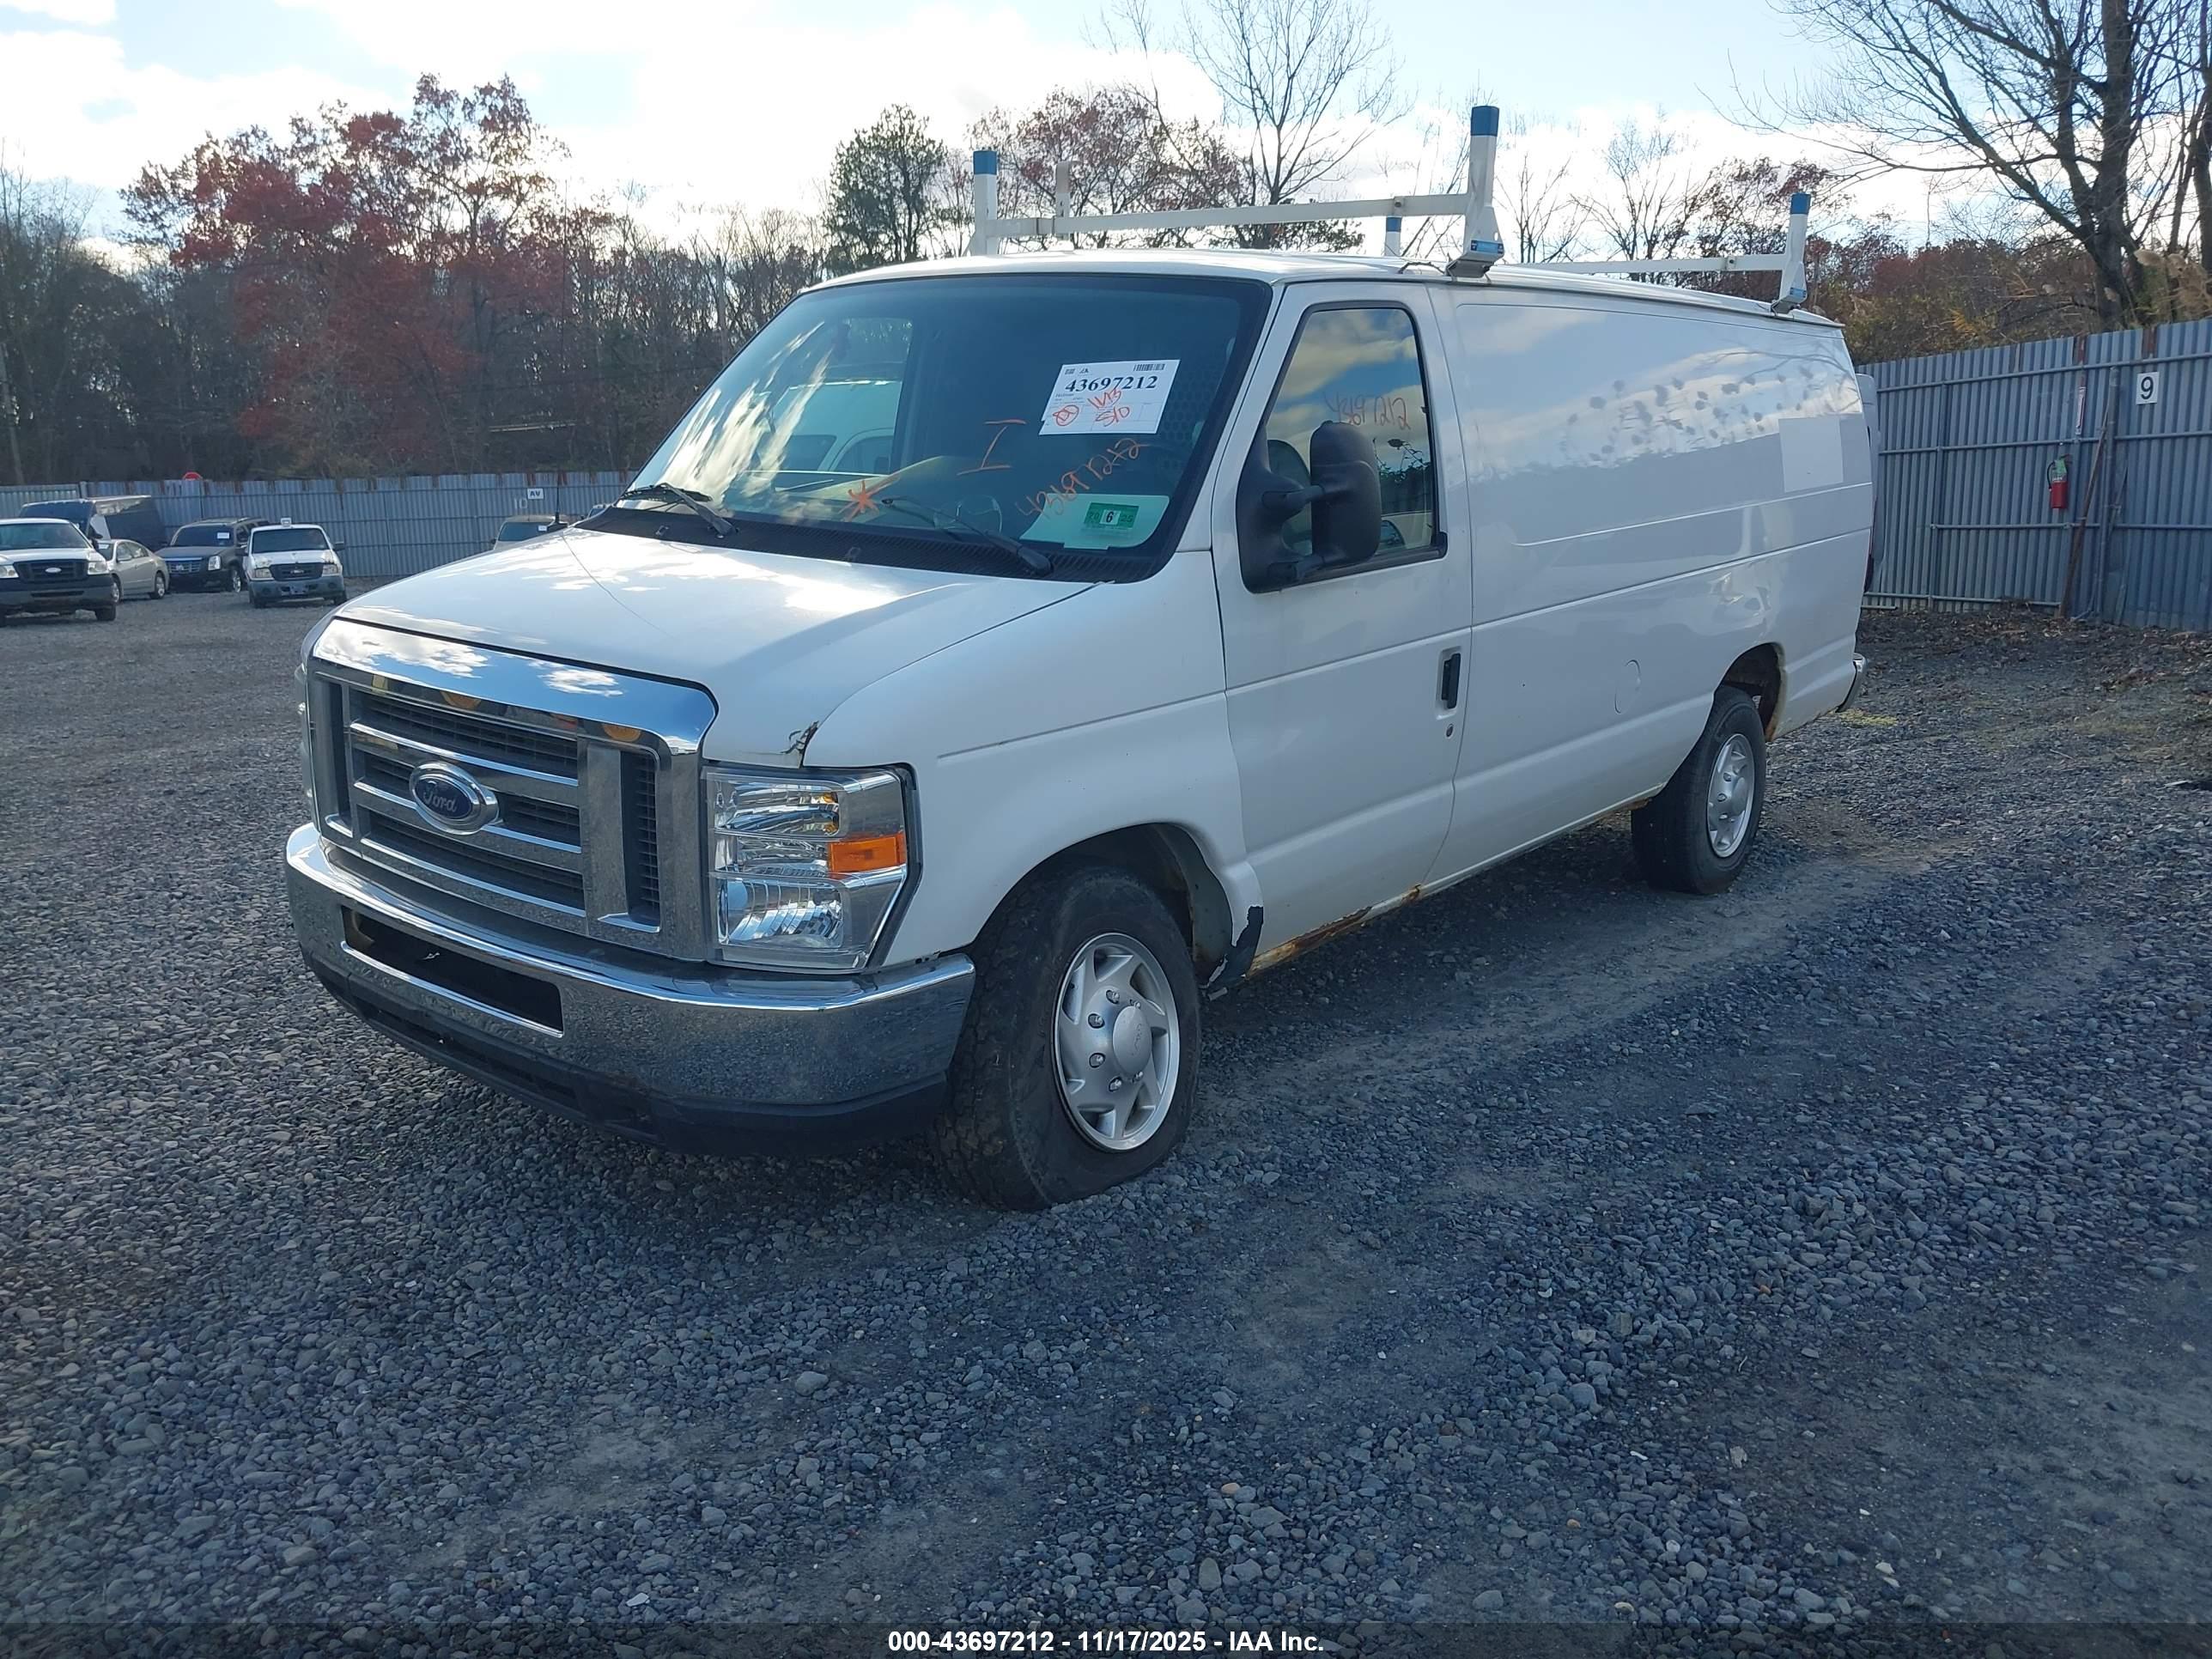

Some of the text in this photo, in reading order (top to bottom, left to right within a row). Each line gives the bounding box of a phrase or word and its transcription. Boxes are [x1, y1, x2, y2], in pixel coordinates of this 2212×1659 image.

[1066, 375, 1158, 392] 43697212
[2140, 375, 2154, 400] 9
[1105, 511, 1115, 523] 6
[423, 781, 458, 813] Ford
